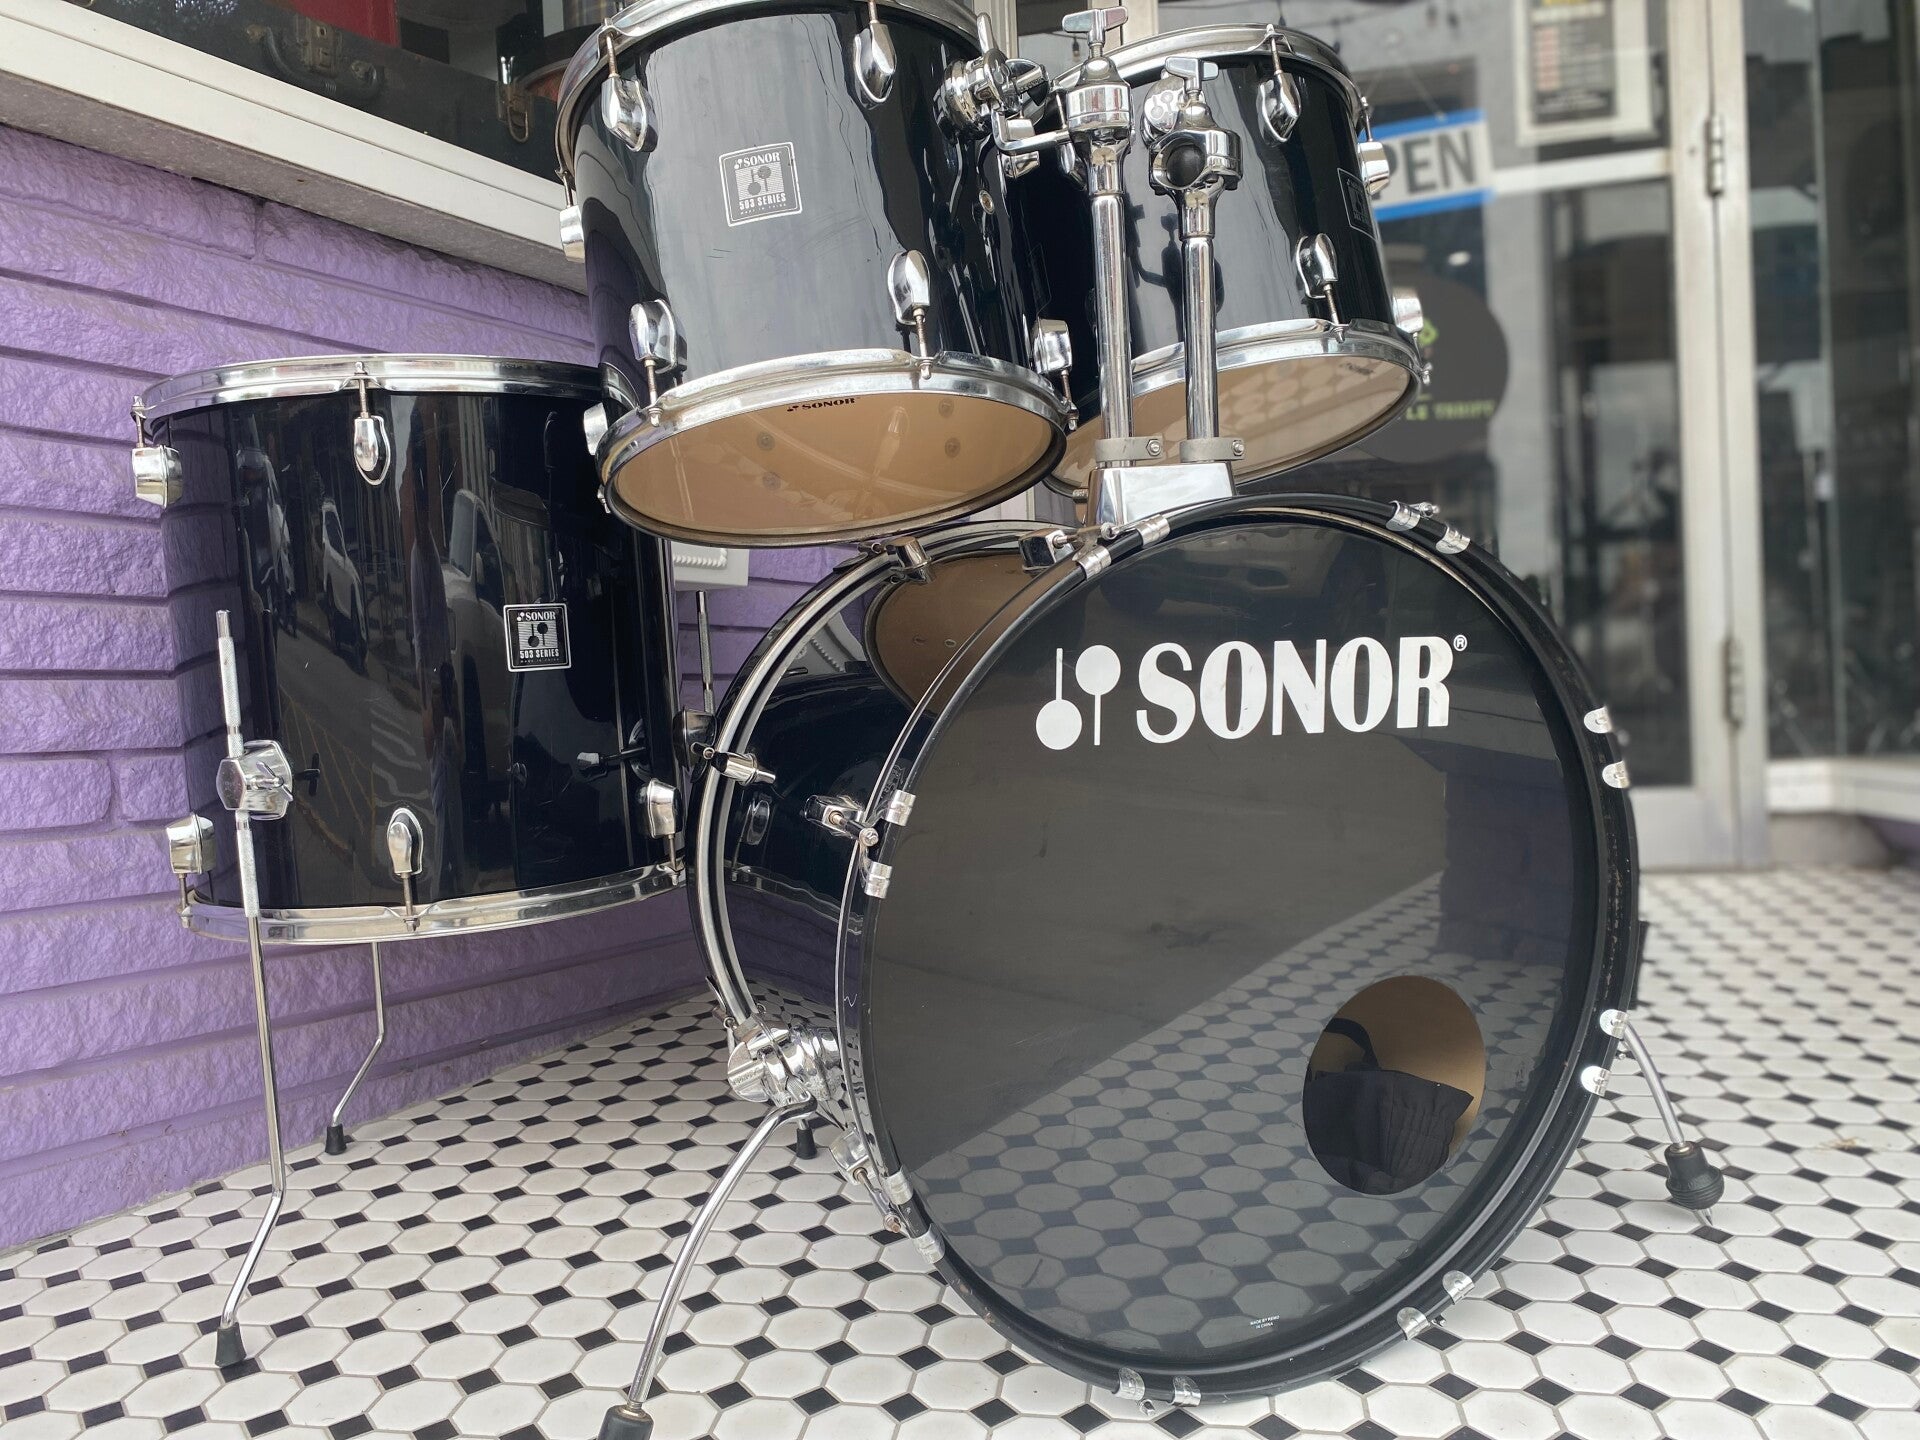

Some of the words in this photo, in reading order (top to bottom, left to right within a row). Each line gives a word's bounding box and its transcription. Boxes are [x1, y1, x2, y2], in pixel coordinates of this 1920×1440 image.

[743, 151, 781, 168] SONOR
[739, 199, 755, 211] 503
[757, 192, 787, 207] SERIES
[802, 397, 855, 410] SONOR
[525, 611, 556, 622] SONOR
[519, 650, 534, 659] 503
[535, 648, 560, 658] SERIES
